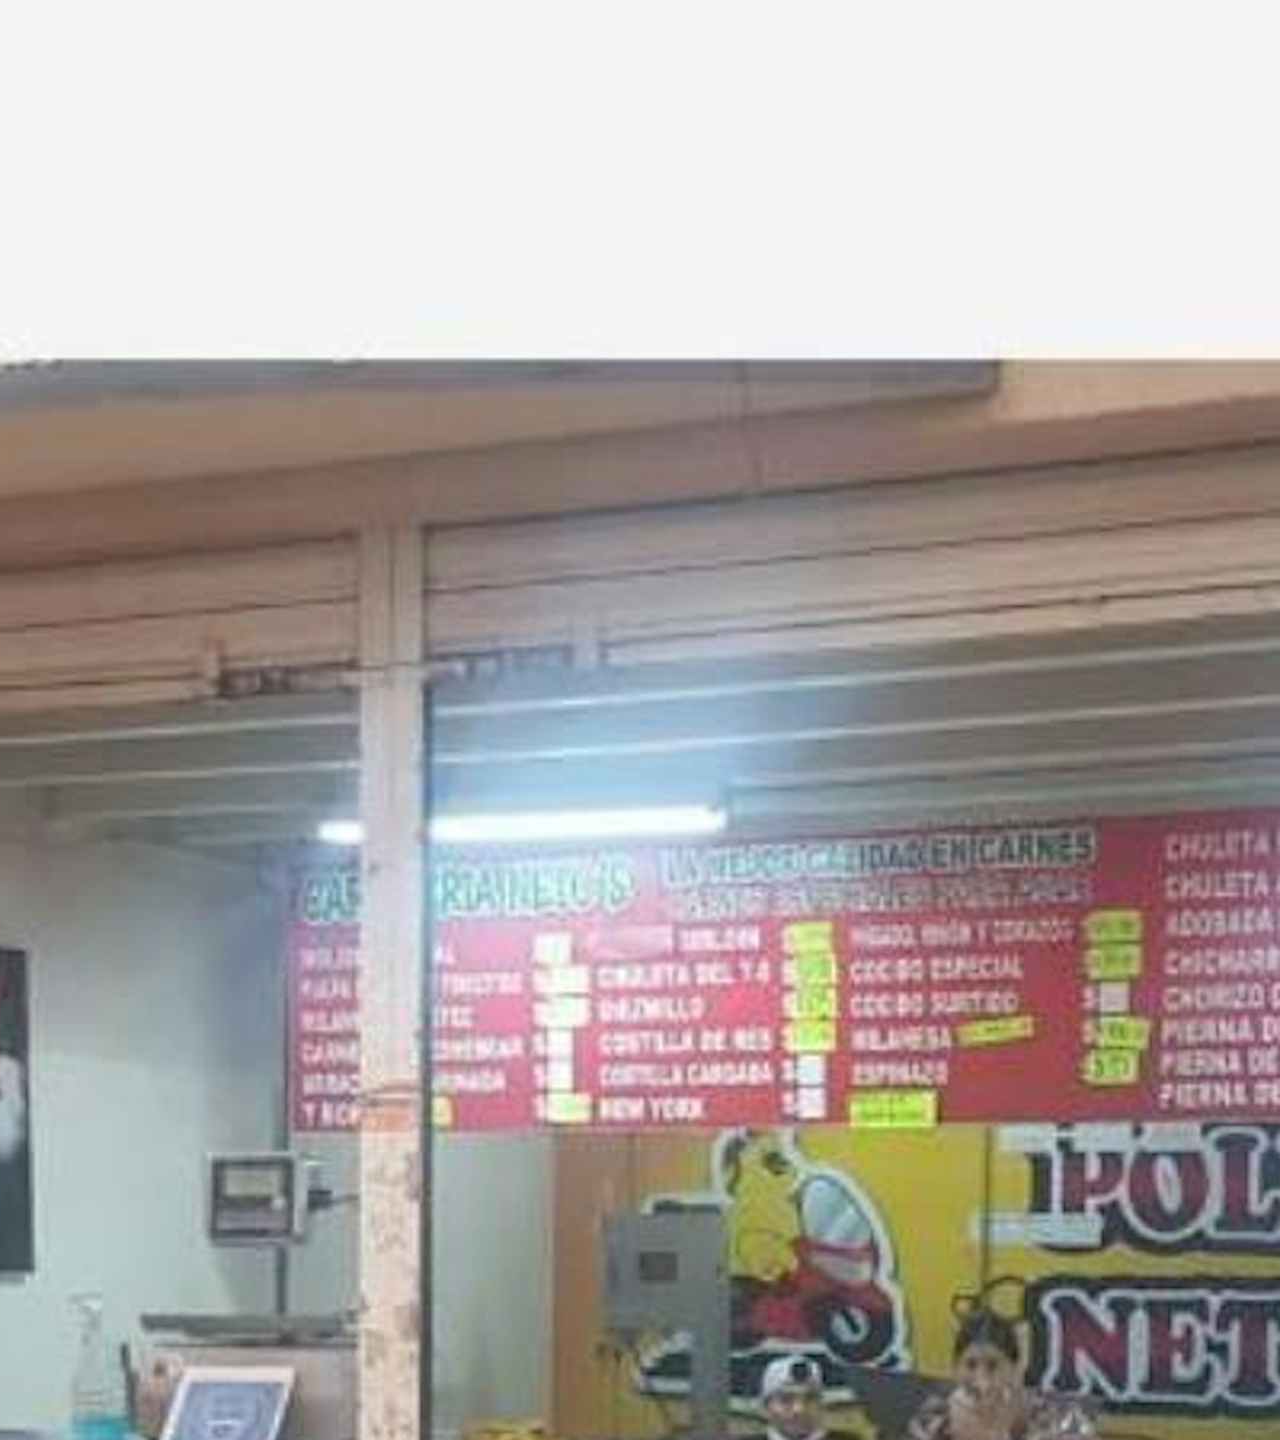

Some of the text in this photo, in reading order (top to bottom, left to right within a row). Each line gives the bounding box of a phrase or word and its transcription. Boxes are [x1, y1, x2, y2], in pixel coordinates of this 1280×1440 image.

[977, 832, 1094, 863] CARNES
[1166, 870, 1270, 899] CHULETA
[1162, 1016, 1254, 1043] PIERNA
[1161, 1048, 1241, 1075] PIERNA
[1247, 1047, 1280, 1074] DE
[599, 1096, 705, 1120] NEW YORK
